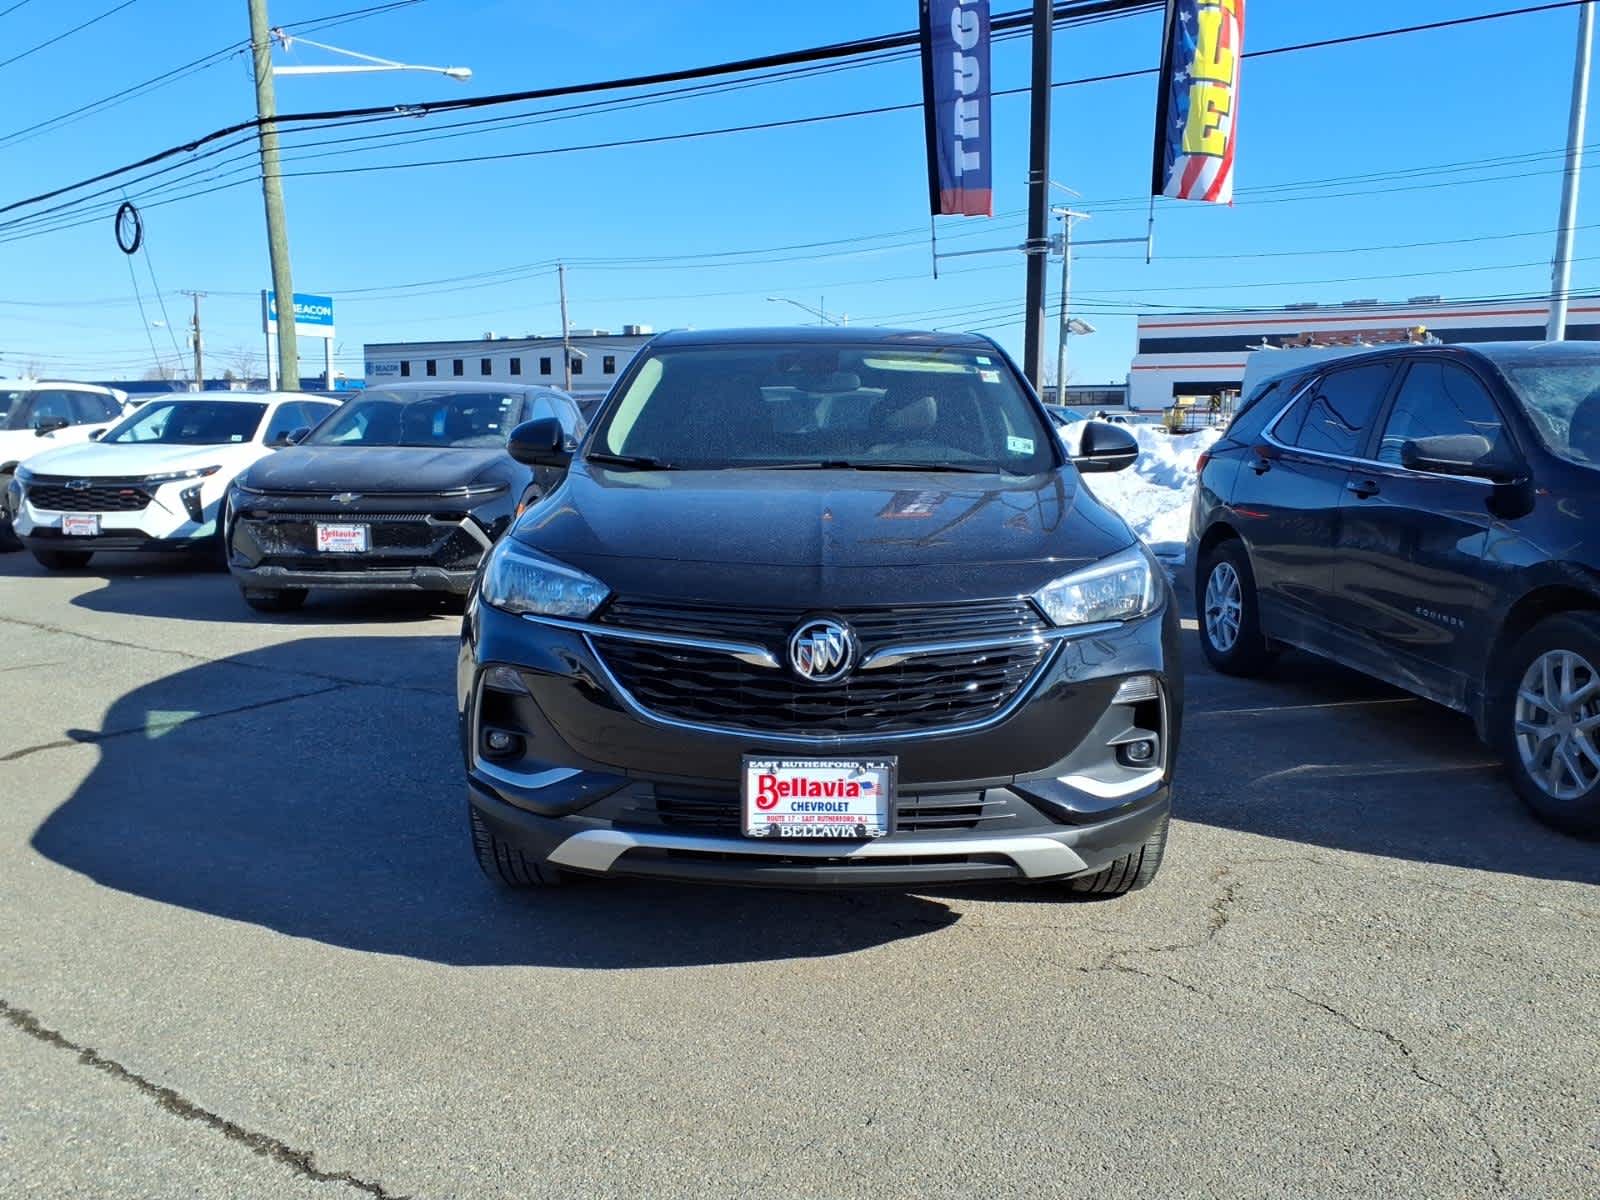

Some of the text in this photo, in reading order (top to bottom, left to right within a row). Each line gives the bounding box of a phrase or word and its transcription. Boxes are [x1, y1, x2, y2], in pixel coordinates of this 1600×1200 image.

[951, 0, 980, 177] TRUC
[1415, 606, 1465, 629] EQUINOX
[756, 774, 859, 810] Bellavia
[790, 801, 850, 812] CHEVROLET
[780, 825, 858, 838] BELLAVIA
